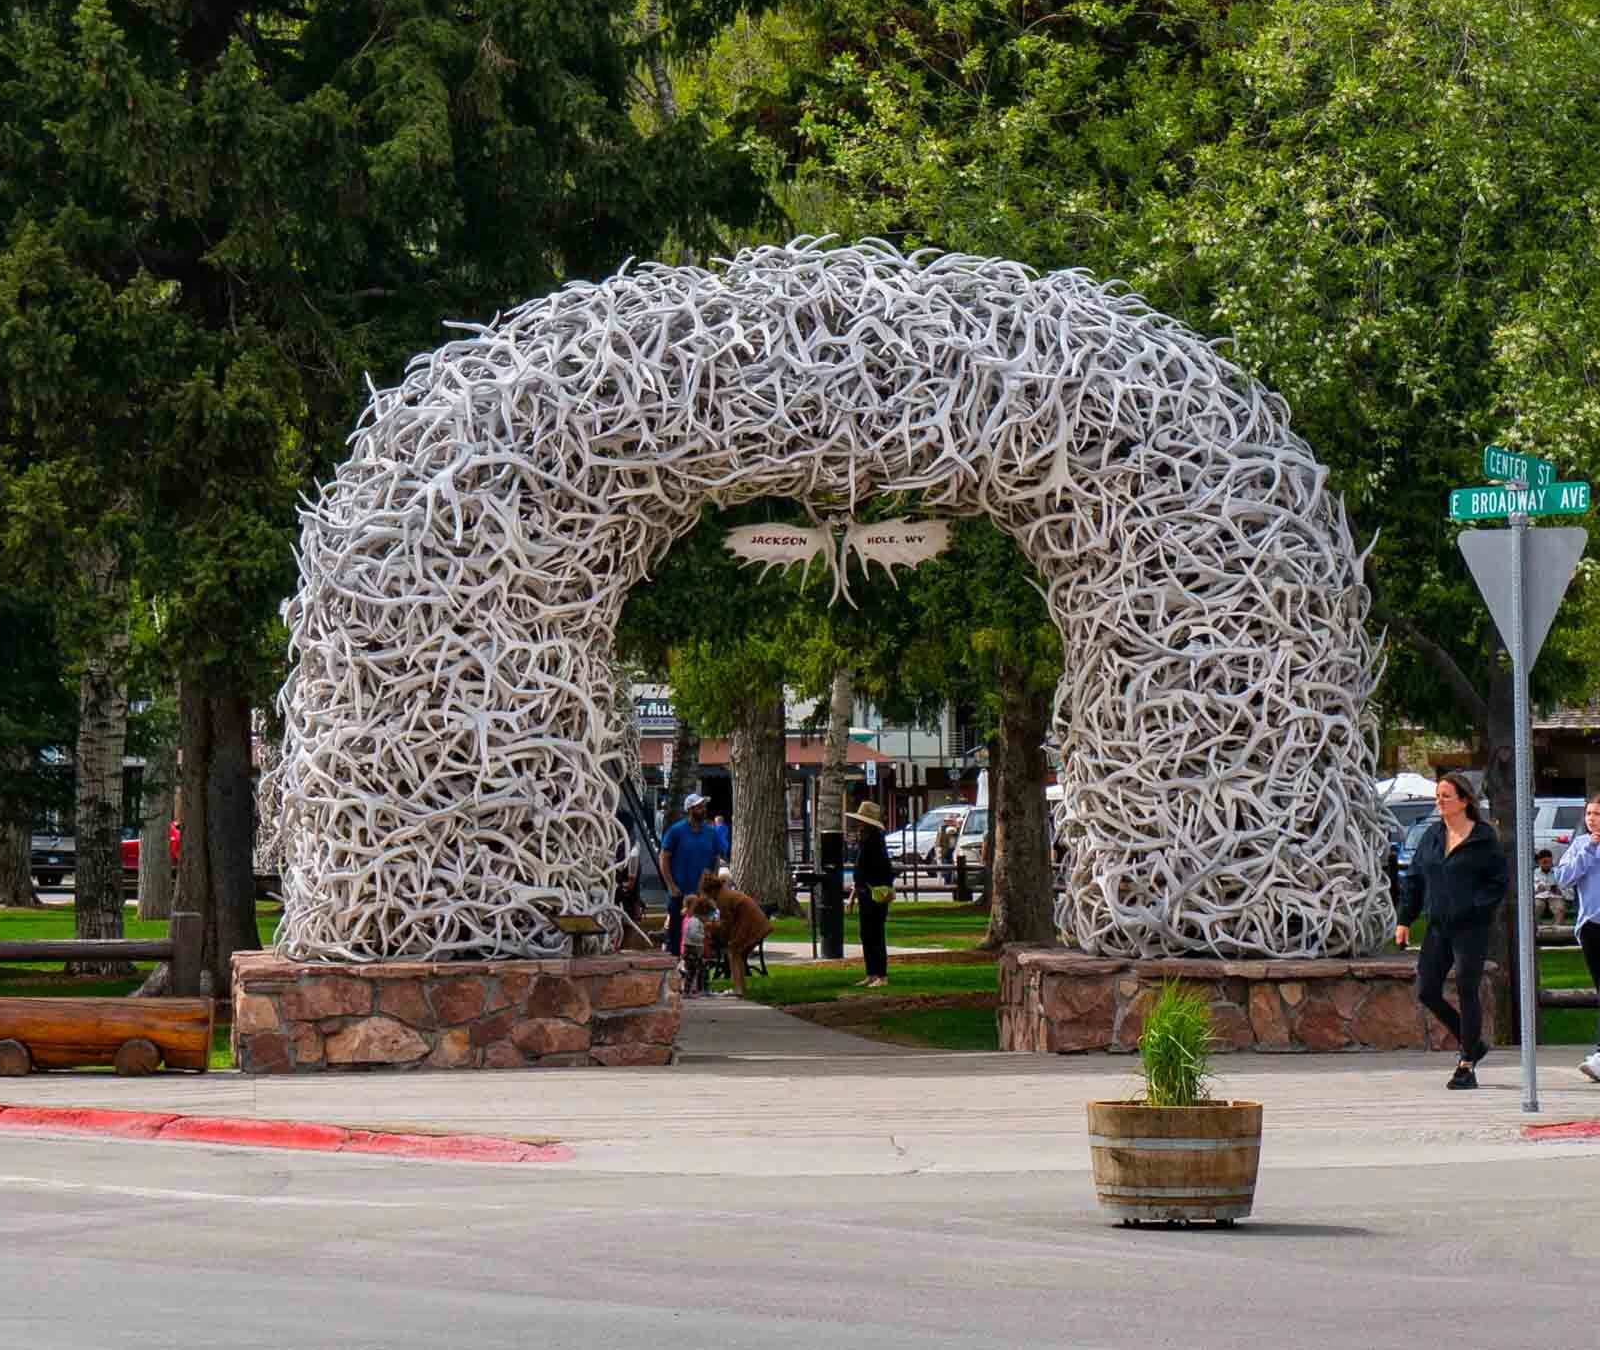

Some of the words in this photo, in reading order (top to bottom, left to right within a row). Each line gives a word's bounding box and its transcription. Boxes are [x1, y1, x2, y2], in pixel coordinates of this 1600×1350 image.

[1489, 451, 1528, 482] CENTER
[1537, 465, 1551, 485] ST
[1452, 494, 1461, 515] E
[1471, 489, 1546, 514] BROADWAY
[1560, 486, 1587, 508] AVE
[751, 535, 808, 546] JACKSON
[905, 535, 925, 545] WY
